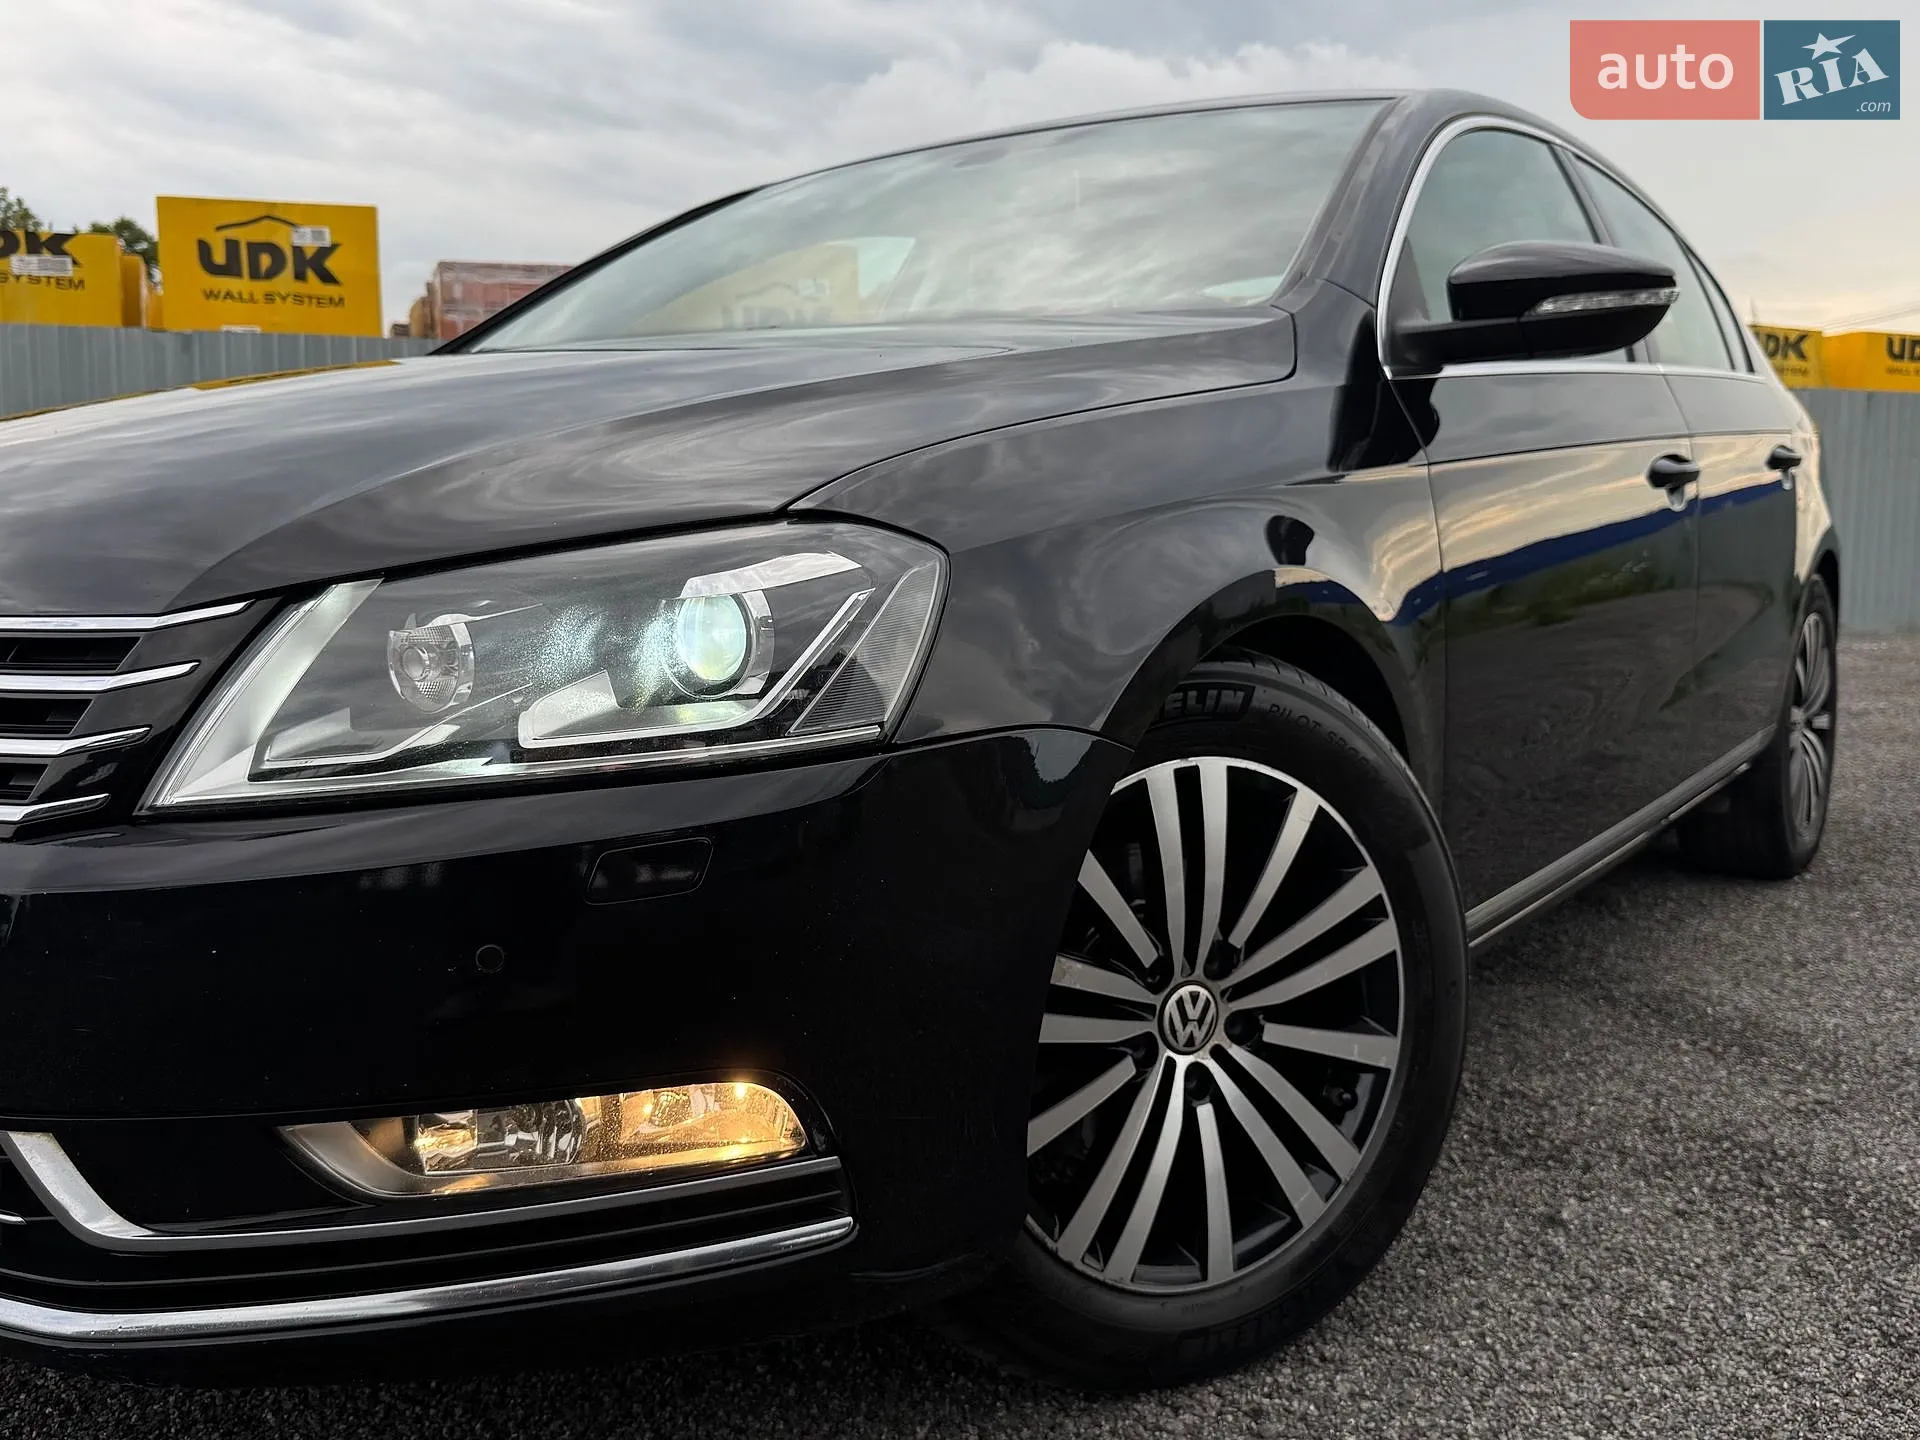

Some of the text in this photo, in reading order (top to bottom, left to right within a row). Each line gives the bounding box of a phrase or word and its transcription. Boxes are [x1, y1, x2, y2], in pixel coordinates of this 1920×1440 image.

[198, 236, 342, 286] UDK
[201, 287, 346, 309] WALL SYSTEM
[1268, 703, 1322, 732] PILOT
